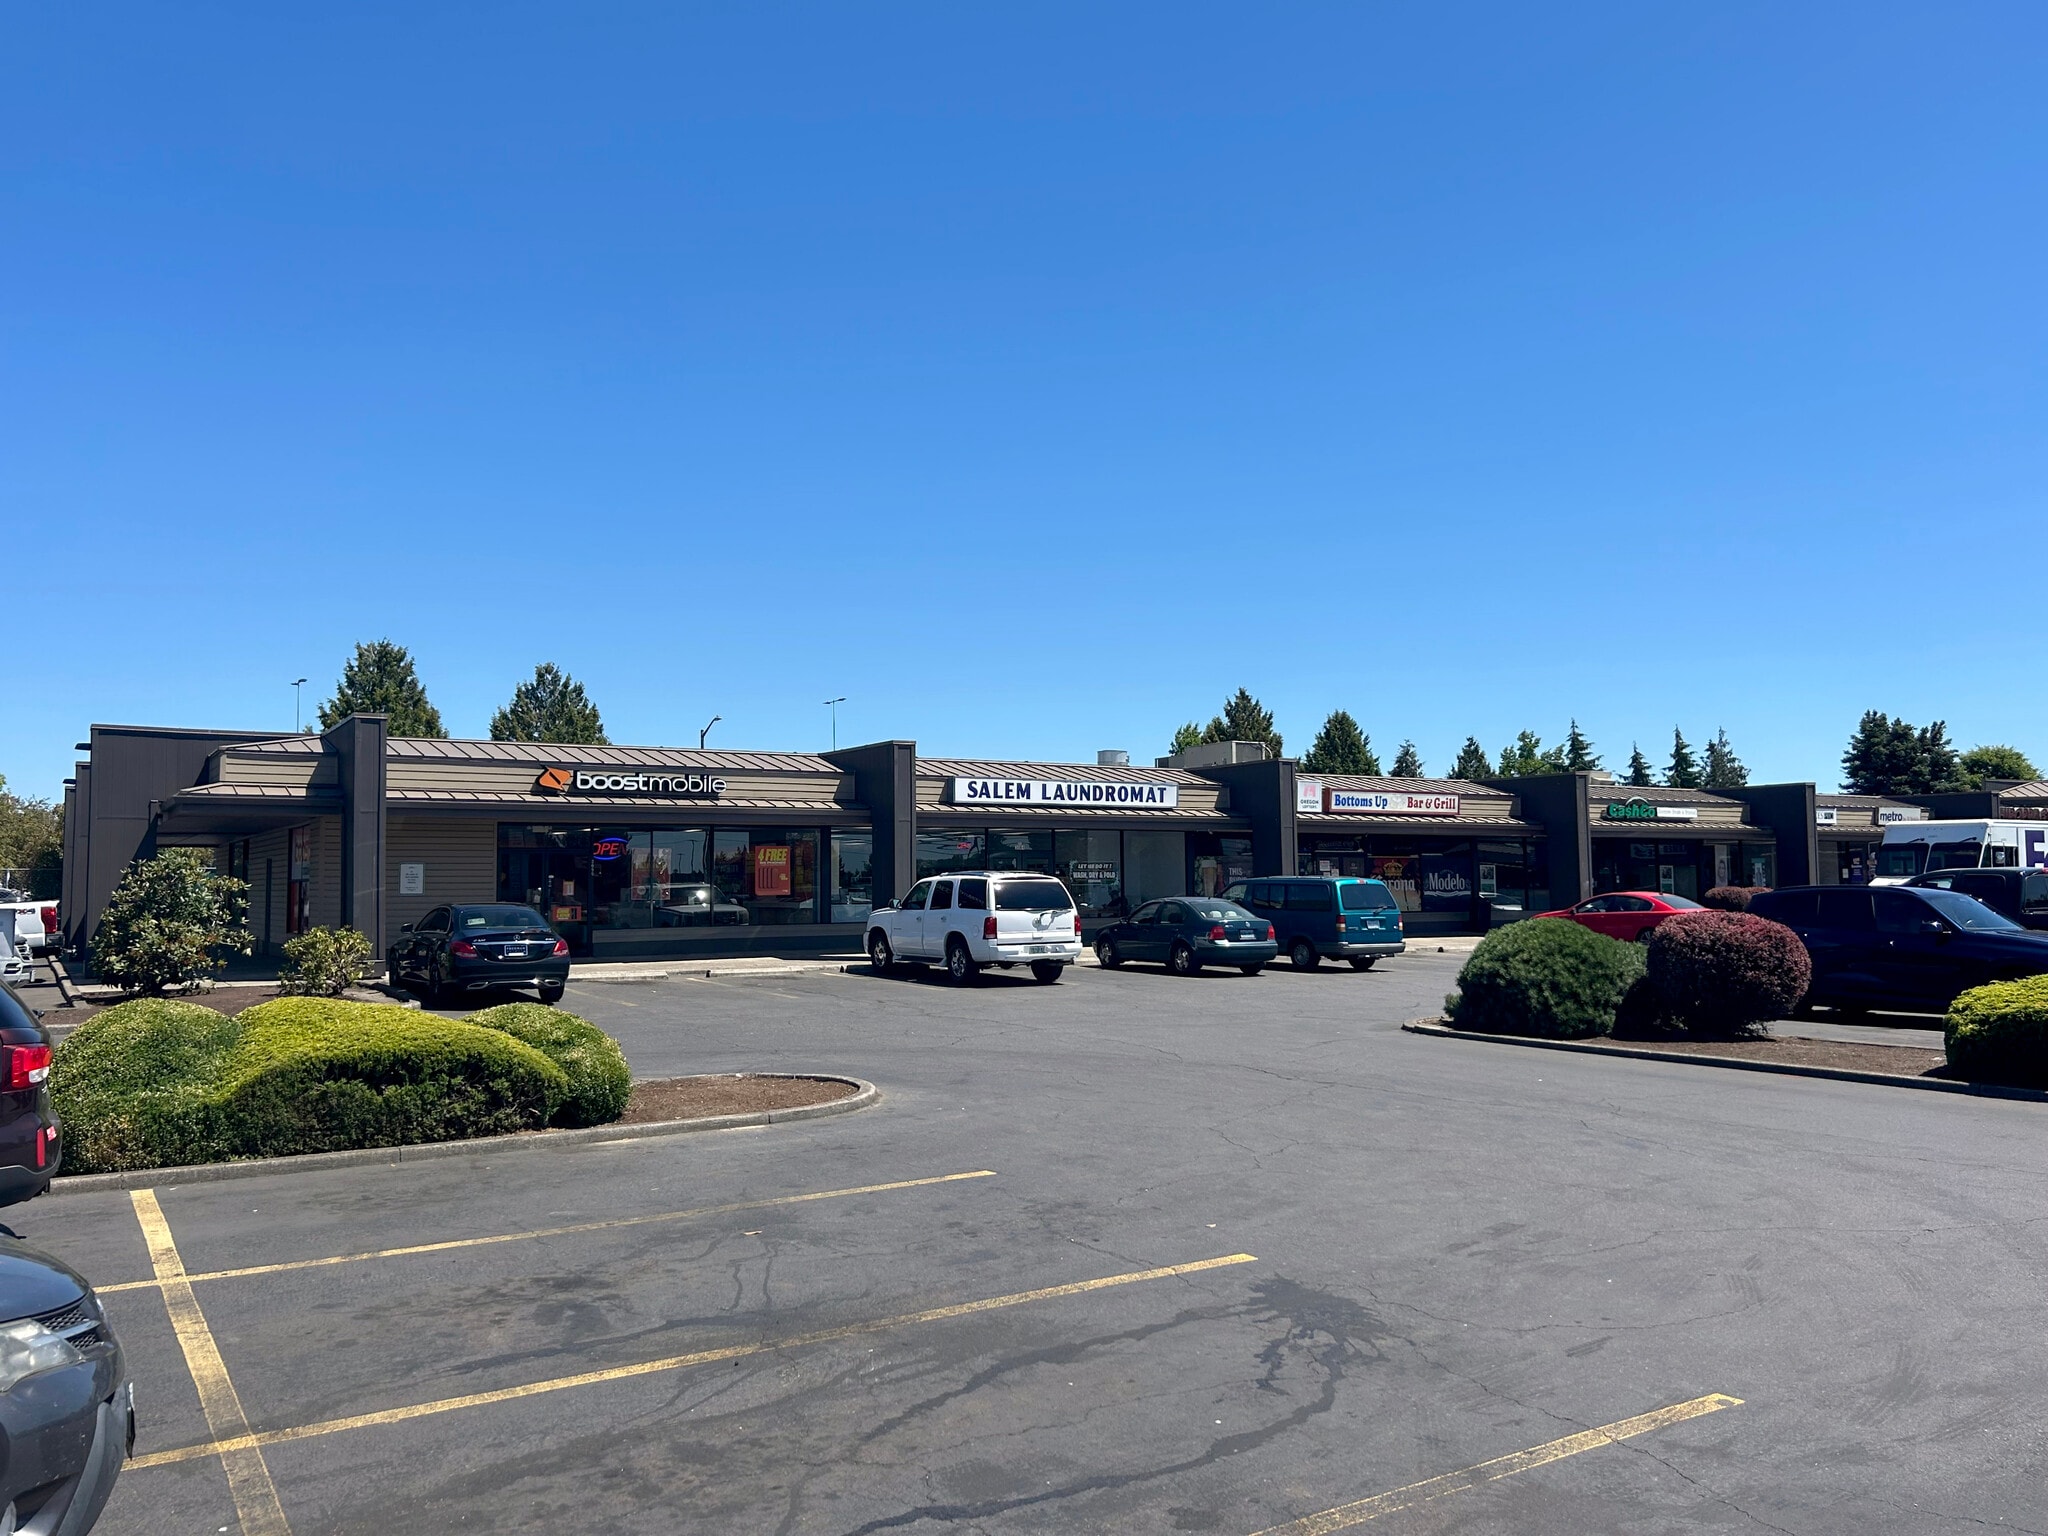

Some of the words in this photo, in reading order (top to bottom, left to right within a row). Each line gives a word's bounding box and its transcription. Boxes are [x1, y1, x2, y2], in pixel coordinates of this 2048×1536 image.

[966, 781, 1031, 800] SALEM
[1041, 783, 1167, 803] LAUNDROMAT
[1334, 794, 1373, 808] Bottoms
[1375, 795, 1388, 810] Up
[1407, 797, 1423, 809] Bar
[1425, 797, 1433, 810] &
[1433, 797, 1456, 810] Grill
[1880, 811, 1903, 822] metro
[758, 848, 765, 861] 4
[765, 848, 788, 861] FREE
[1088, 871, 1099, 879] DRY
[1103, 871, 1116, 879] FOLD
[1228, 867, 1243, 876] THIS
[1428, 872, 1465, 890] Modelo
